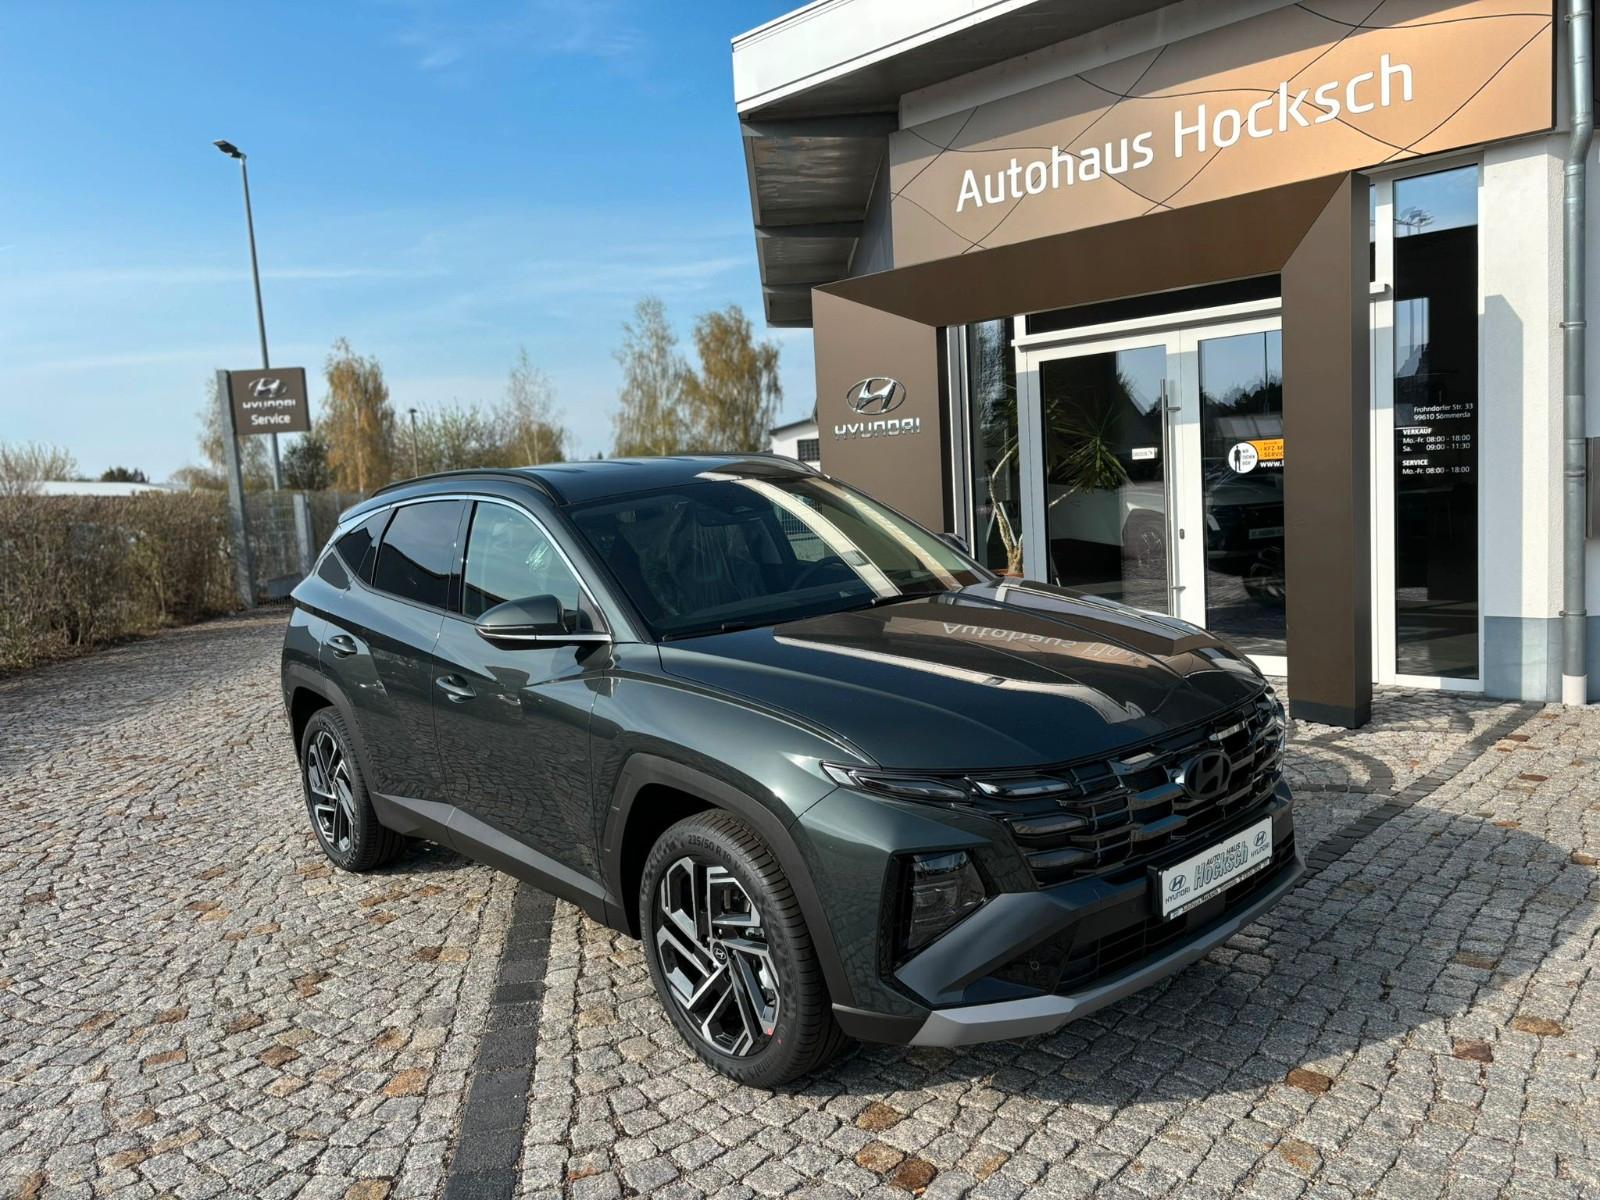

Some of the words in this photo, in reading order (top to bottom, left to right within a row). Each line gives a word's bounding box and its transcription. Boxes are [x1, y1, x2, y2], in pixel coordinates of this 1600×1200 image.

[956, 131, 1154, 213] Autohaus
[1173, 53, 1414, 159] Hocksch
[1413, 405, 1451, 413] Frohndorfer
[251, 413, 291, 425] Service
[1413, 413, 1435, 421] 99610
[1436, 411, 1471, 419] Sömmerda
[834, 417, 920, 440] HYUNDAI
[1402, 427, 1432, 435] VERKAUF
[1402, 436, 1424, 444] Mo.-Fr.
[1426, 435, 1445, 443] 08:00
[1426, 443, 1445, 451] 09:00
[1402, 467, 1424, 475] Mo.-Fr.
[688, 834, 715, 851] 235/50
[1193, 840, 1249, 891] Hocksch
[1165, 886, 1190, 904] HYUNDAI
